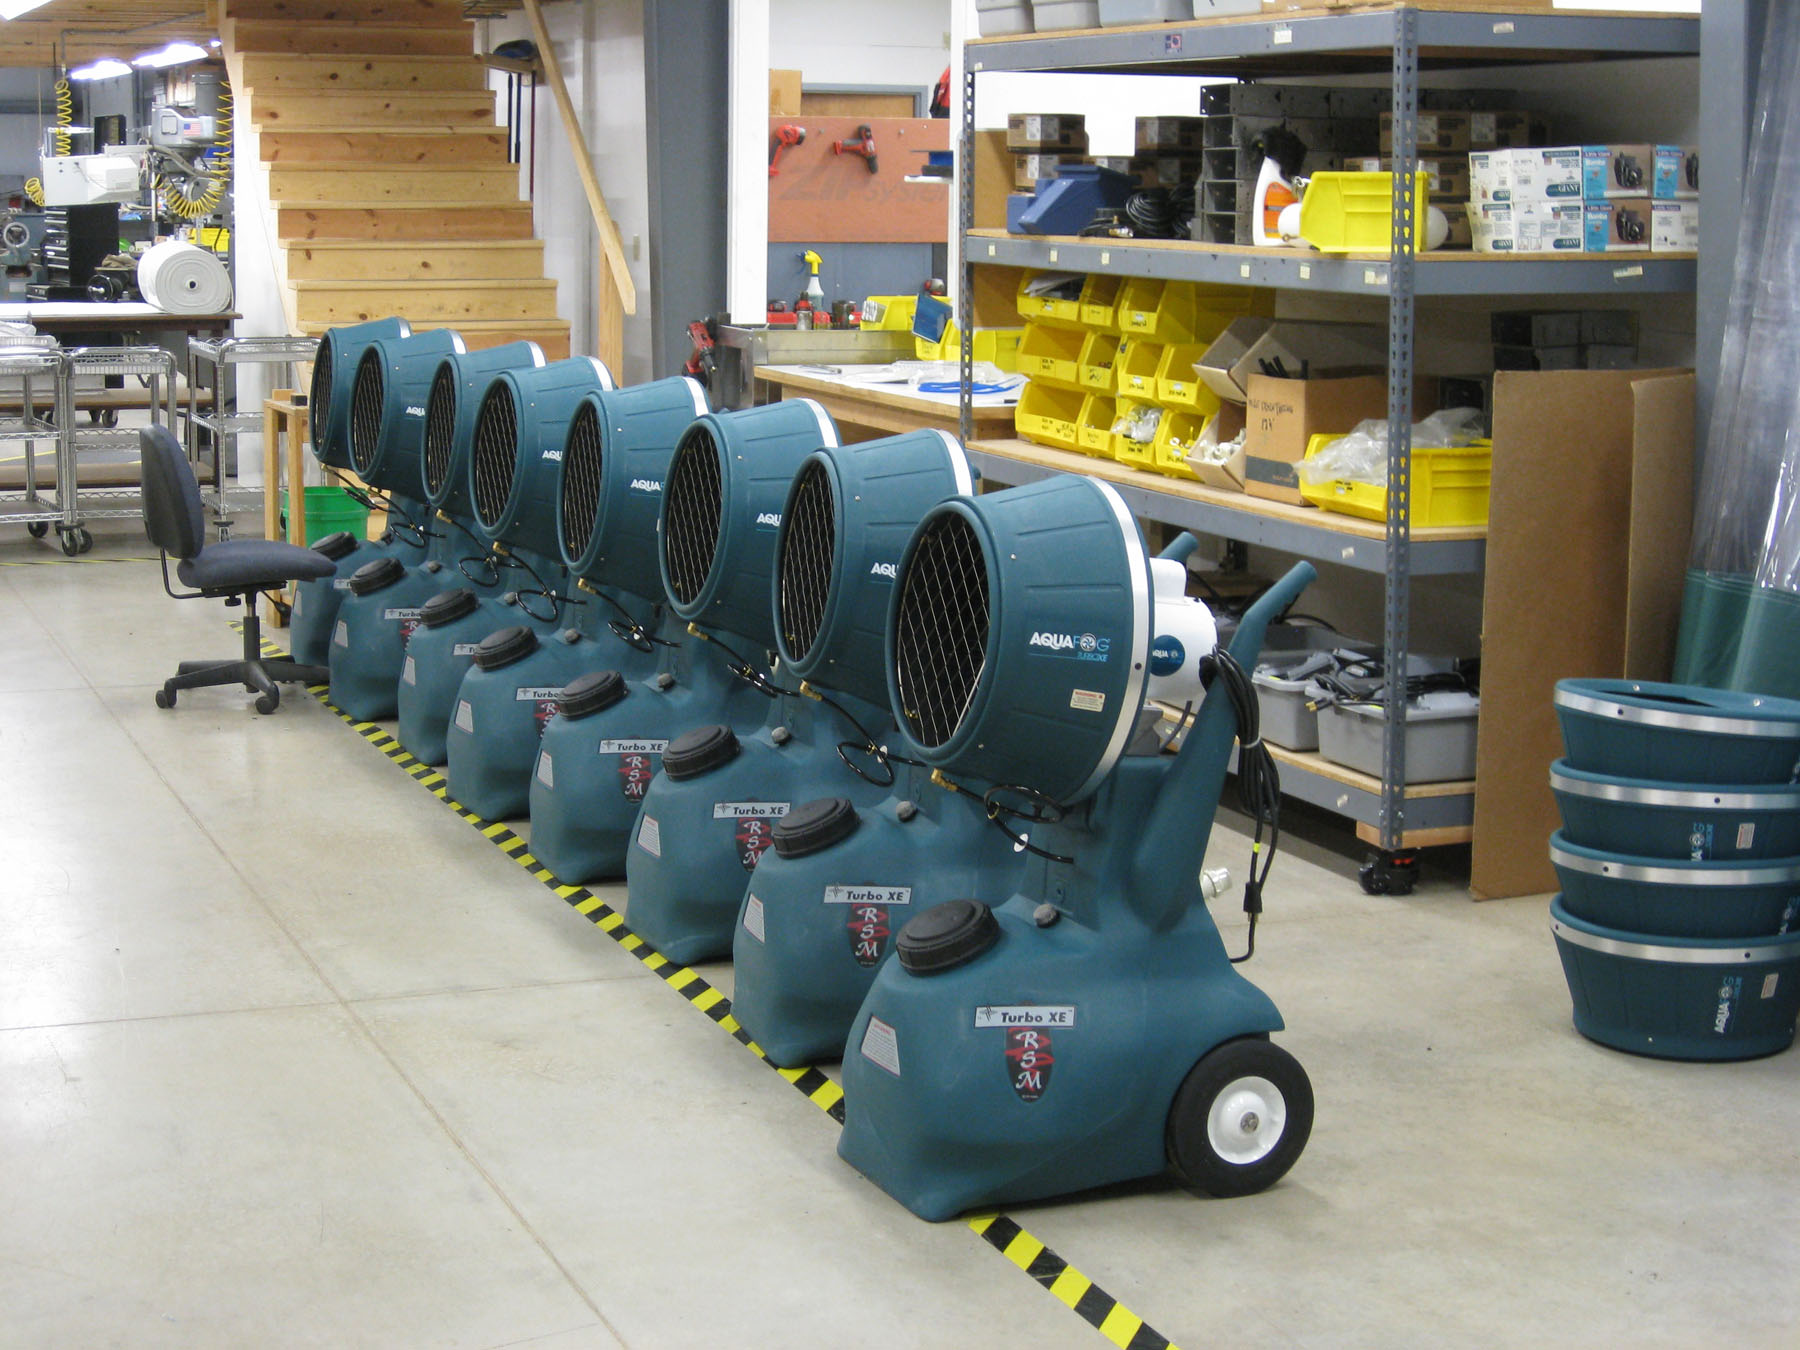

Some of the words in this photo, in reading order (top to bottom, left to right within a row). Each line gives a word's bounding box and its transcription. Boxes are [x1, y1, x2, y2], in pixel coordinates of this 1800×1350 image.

[405, 406, 425, 416] AQU
[542, 450, 563, 461] AQU
[756, 512, 782, 527] AQU
[870, 562, 899, 579] AQU
[617, 743, 646, 751] Turbo
[650, 743, 663, 751] XE
[733, 806, 765, 815] Turbo
[769, 806, 784, 815] XE
[847, 890, 883, 901] Turbo
[888, 891, 904, 901] XE
[1001, 1012, 1043, 1023] Turbo
[1048, 1012, 1067, 1023] XE
